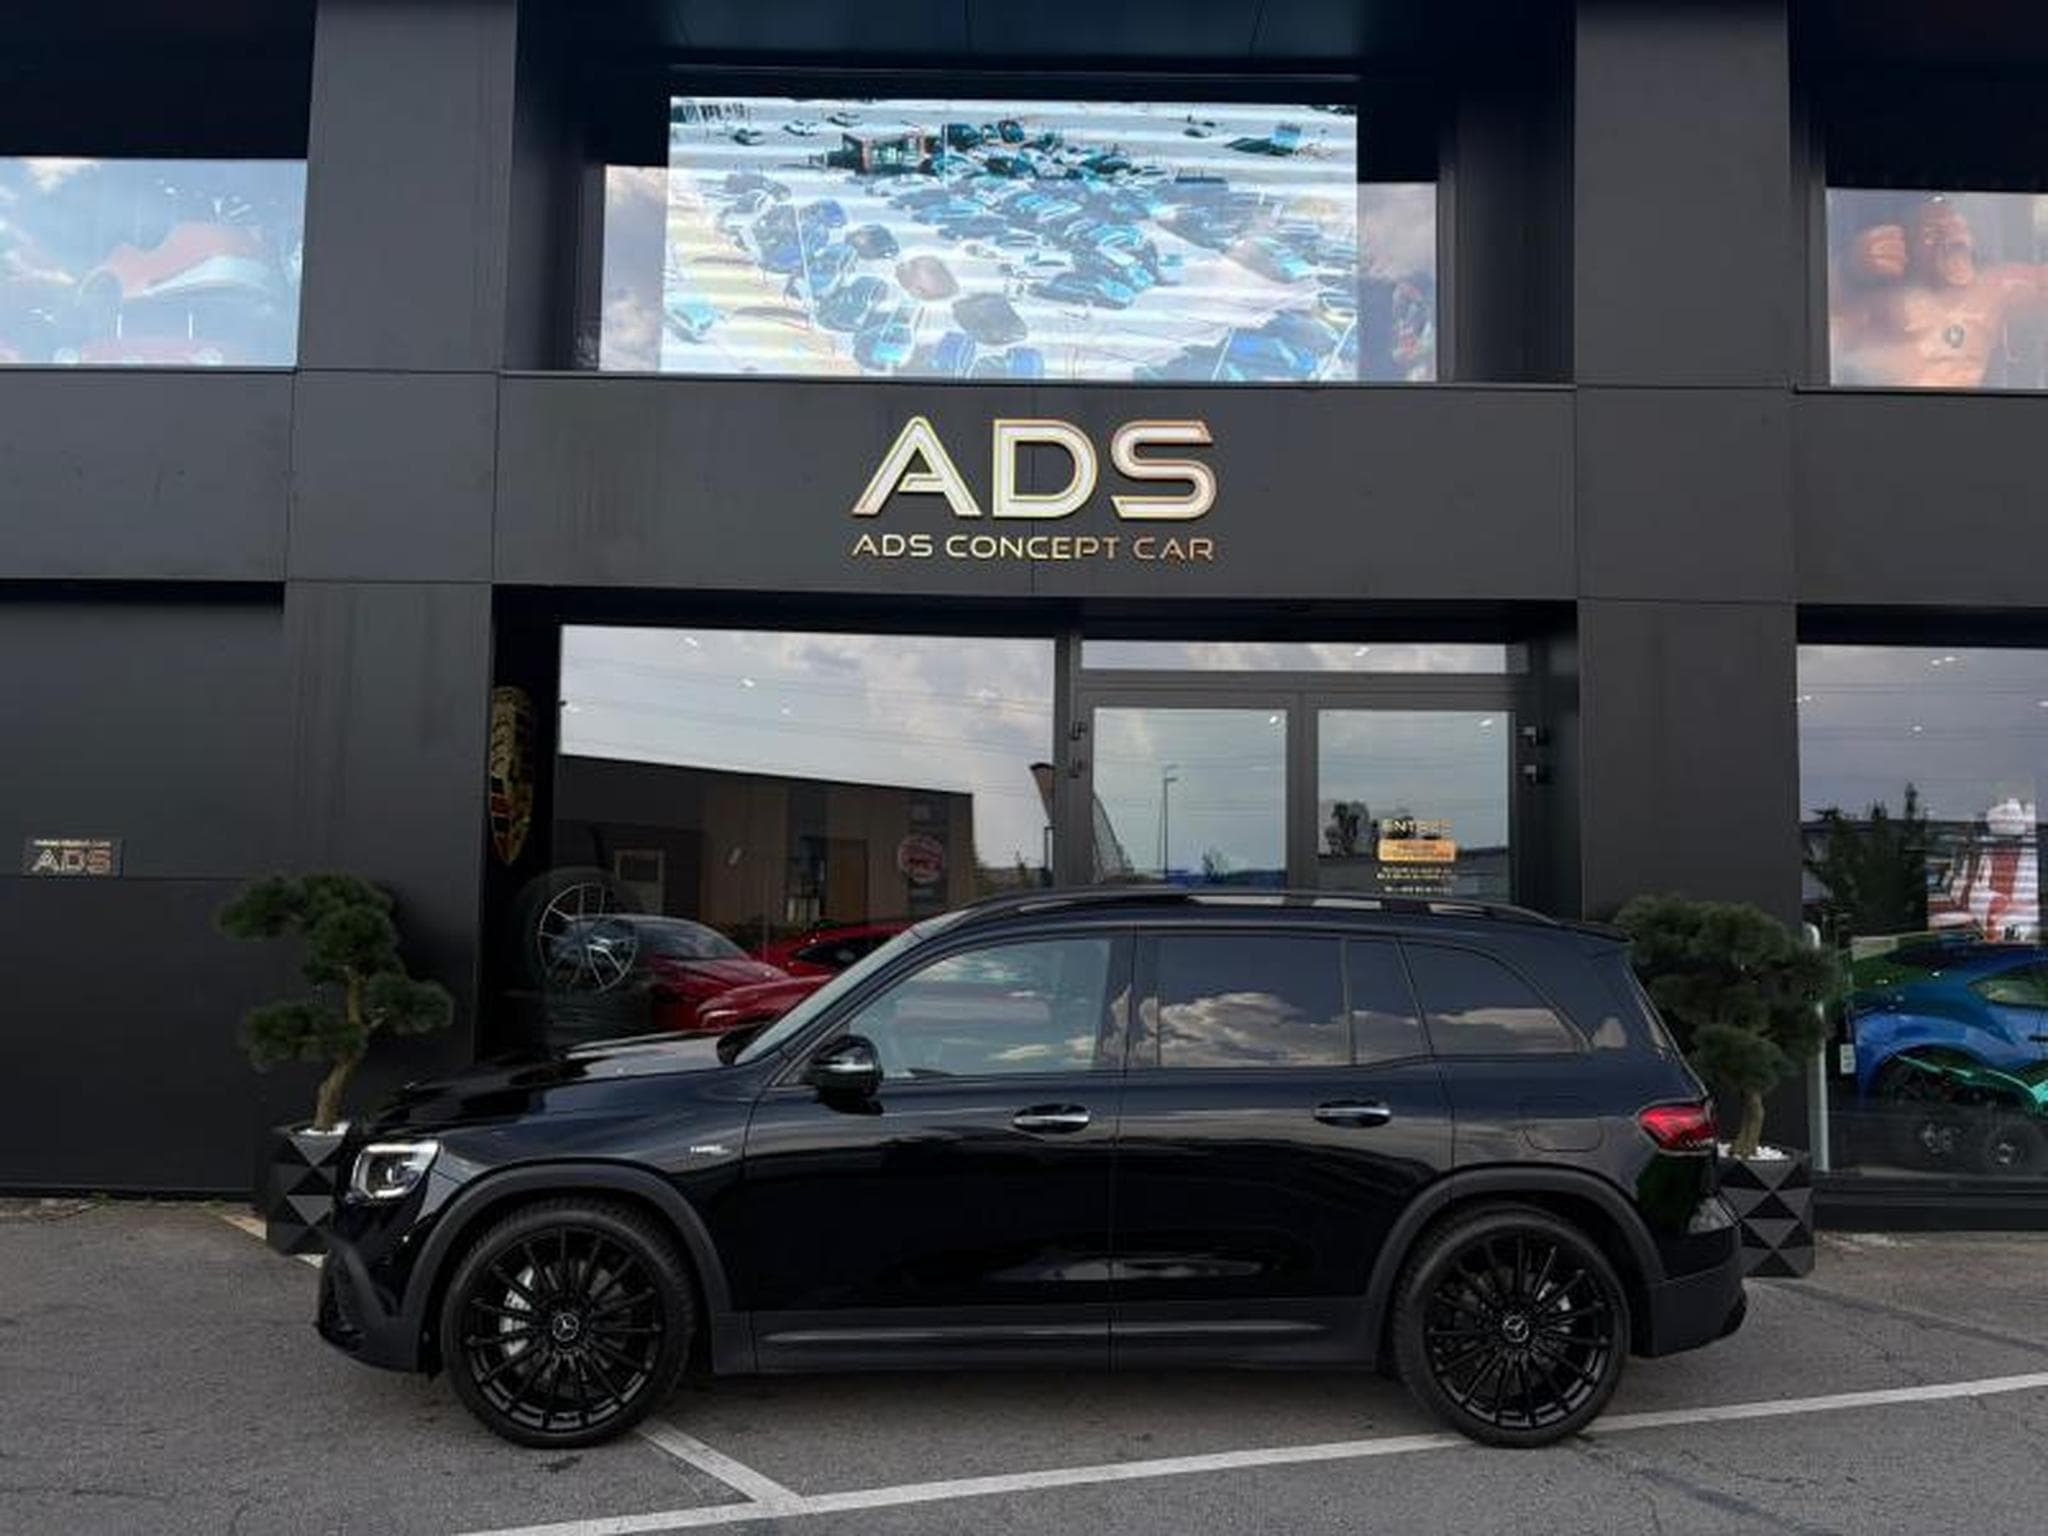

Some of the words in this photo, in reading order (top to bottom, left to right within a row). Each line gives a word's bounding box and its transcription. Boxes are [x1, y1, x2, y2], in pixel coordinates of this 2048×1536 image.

[851, 416, 1217, 519] ADS
[851, 534, 933, 557] ADS
[945, 535, 1120, 559] CONCEPT
[1133, 537, 1215, 559] CAR
[31, 849, 111, 874] ADS
